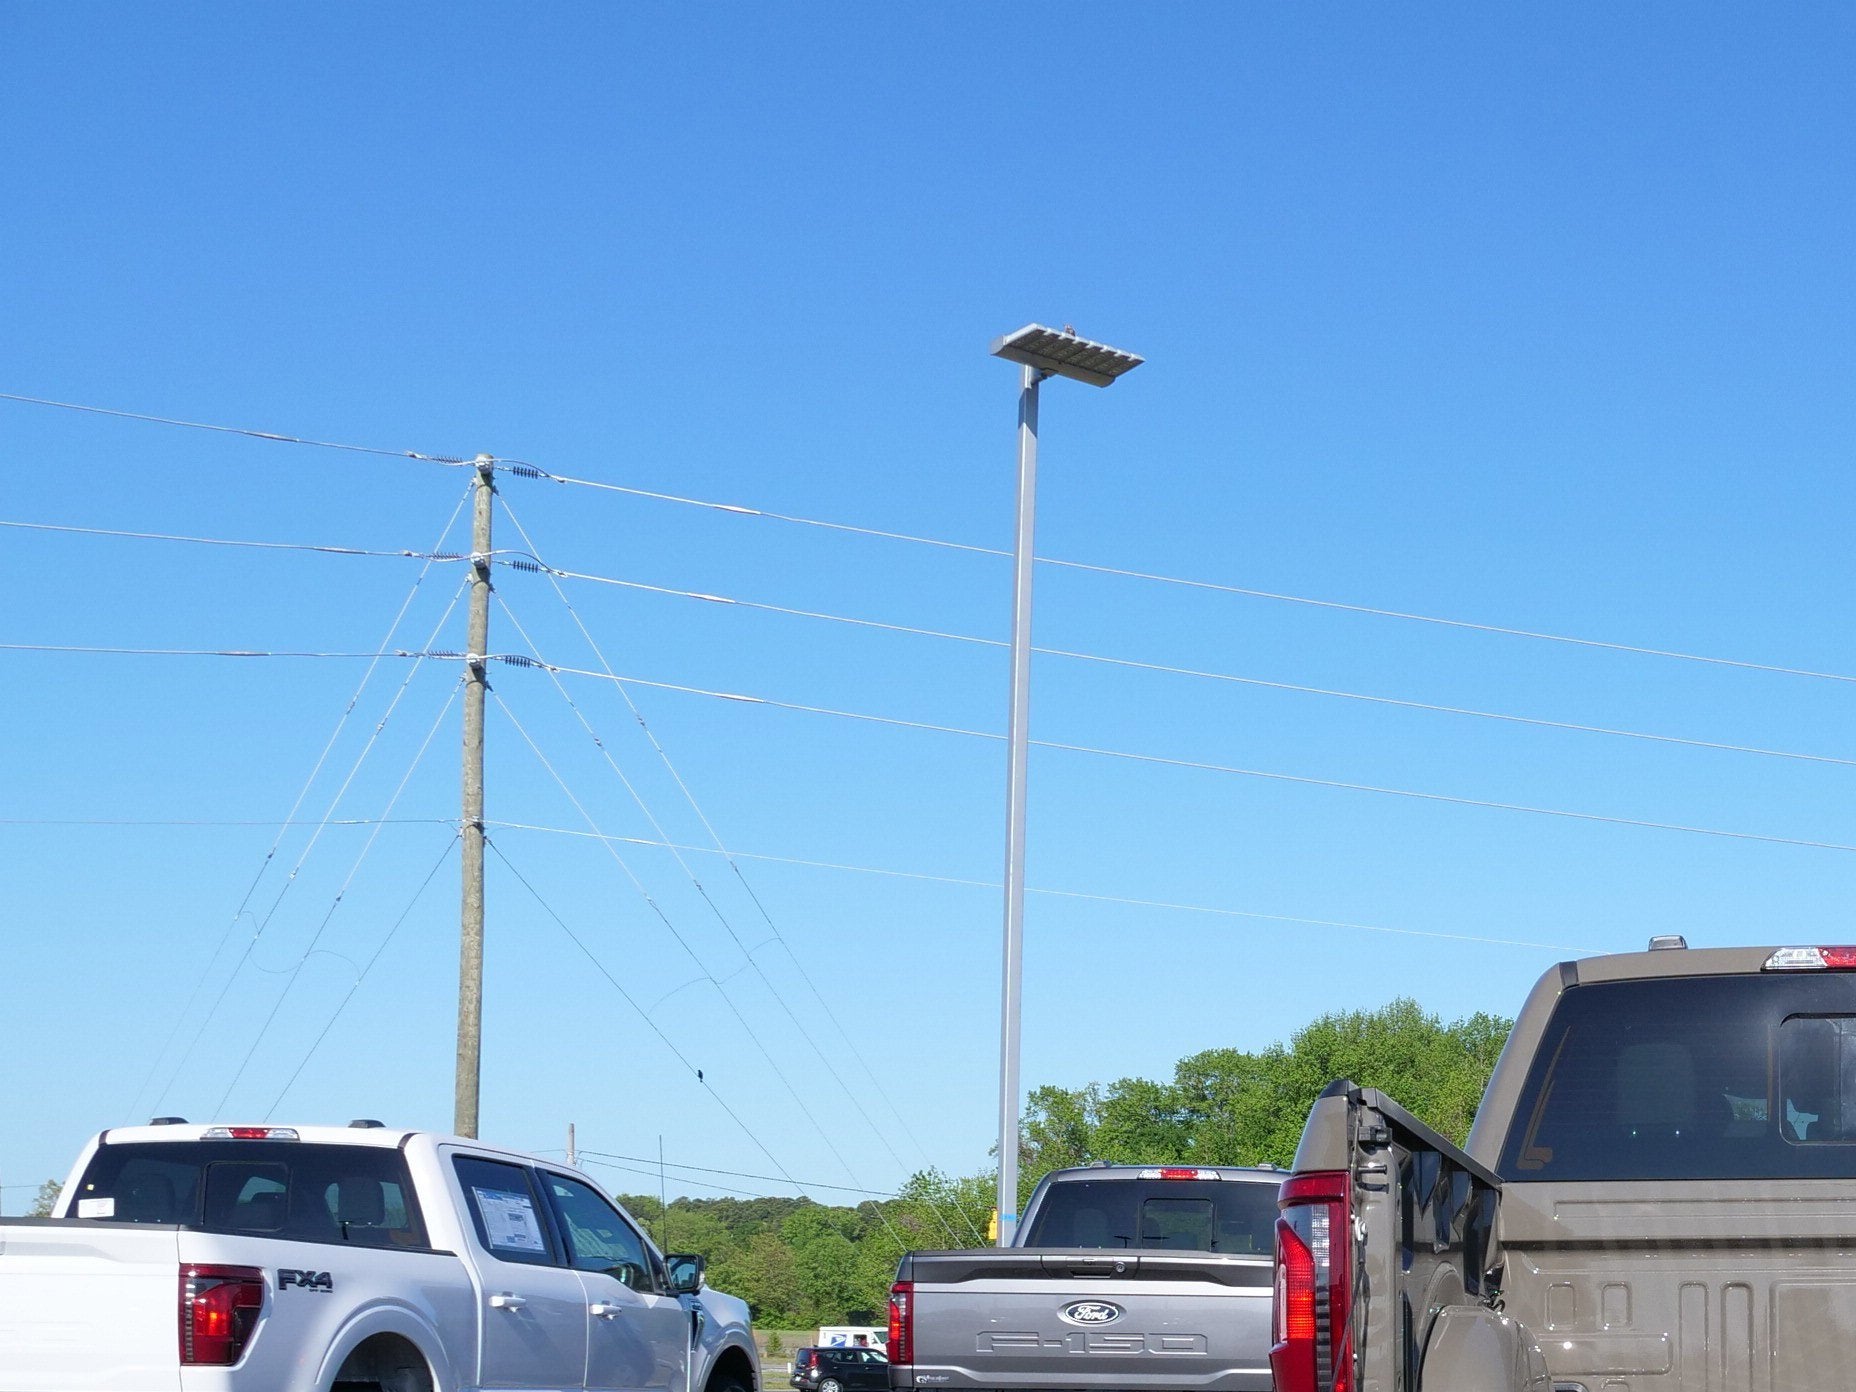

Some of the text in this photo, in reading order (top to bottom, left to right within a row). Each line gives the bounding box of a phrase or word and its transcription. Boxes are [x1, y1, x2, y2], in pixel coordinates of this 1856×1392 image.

[277, 1268, 333, 1290] FX4
[1074, 1305, 1109, 1321] Ford
[976, 1331, 1208, 1355] F-150
